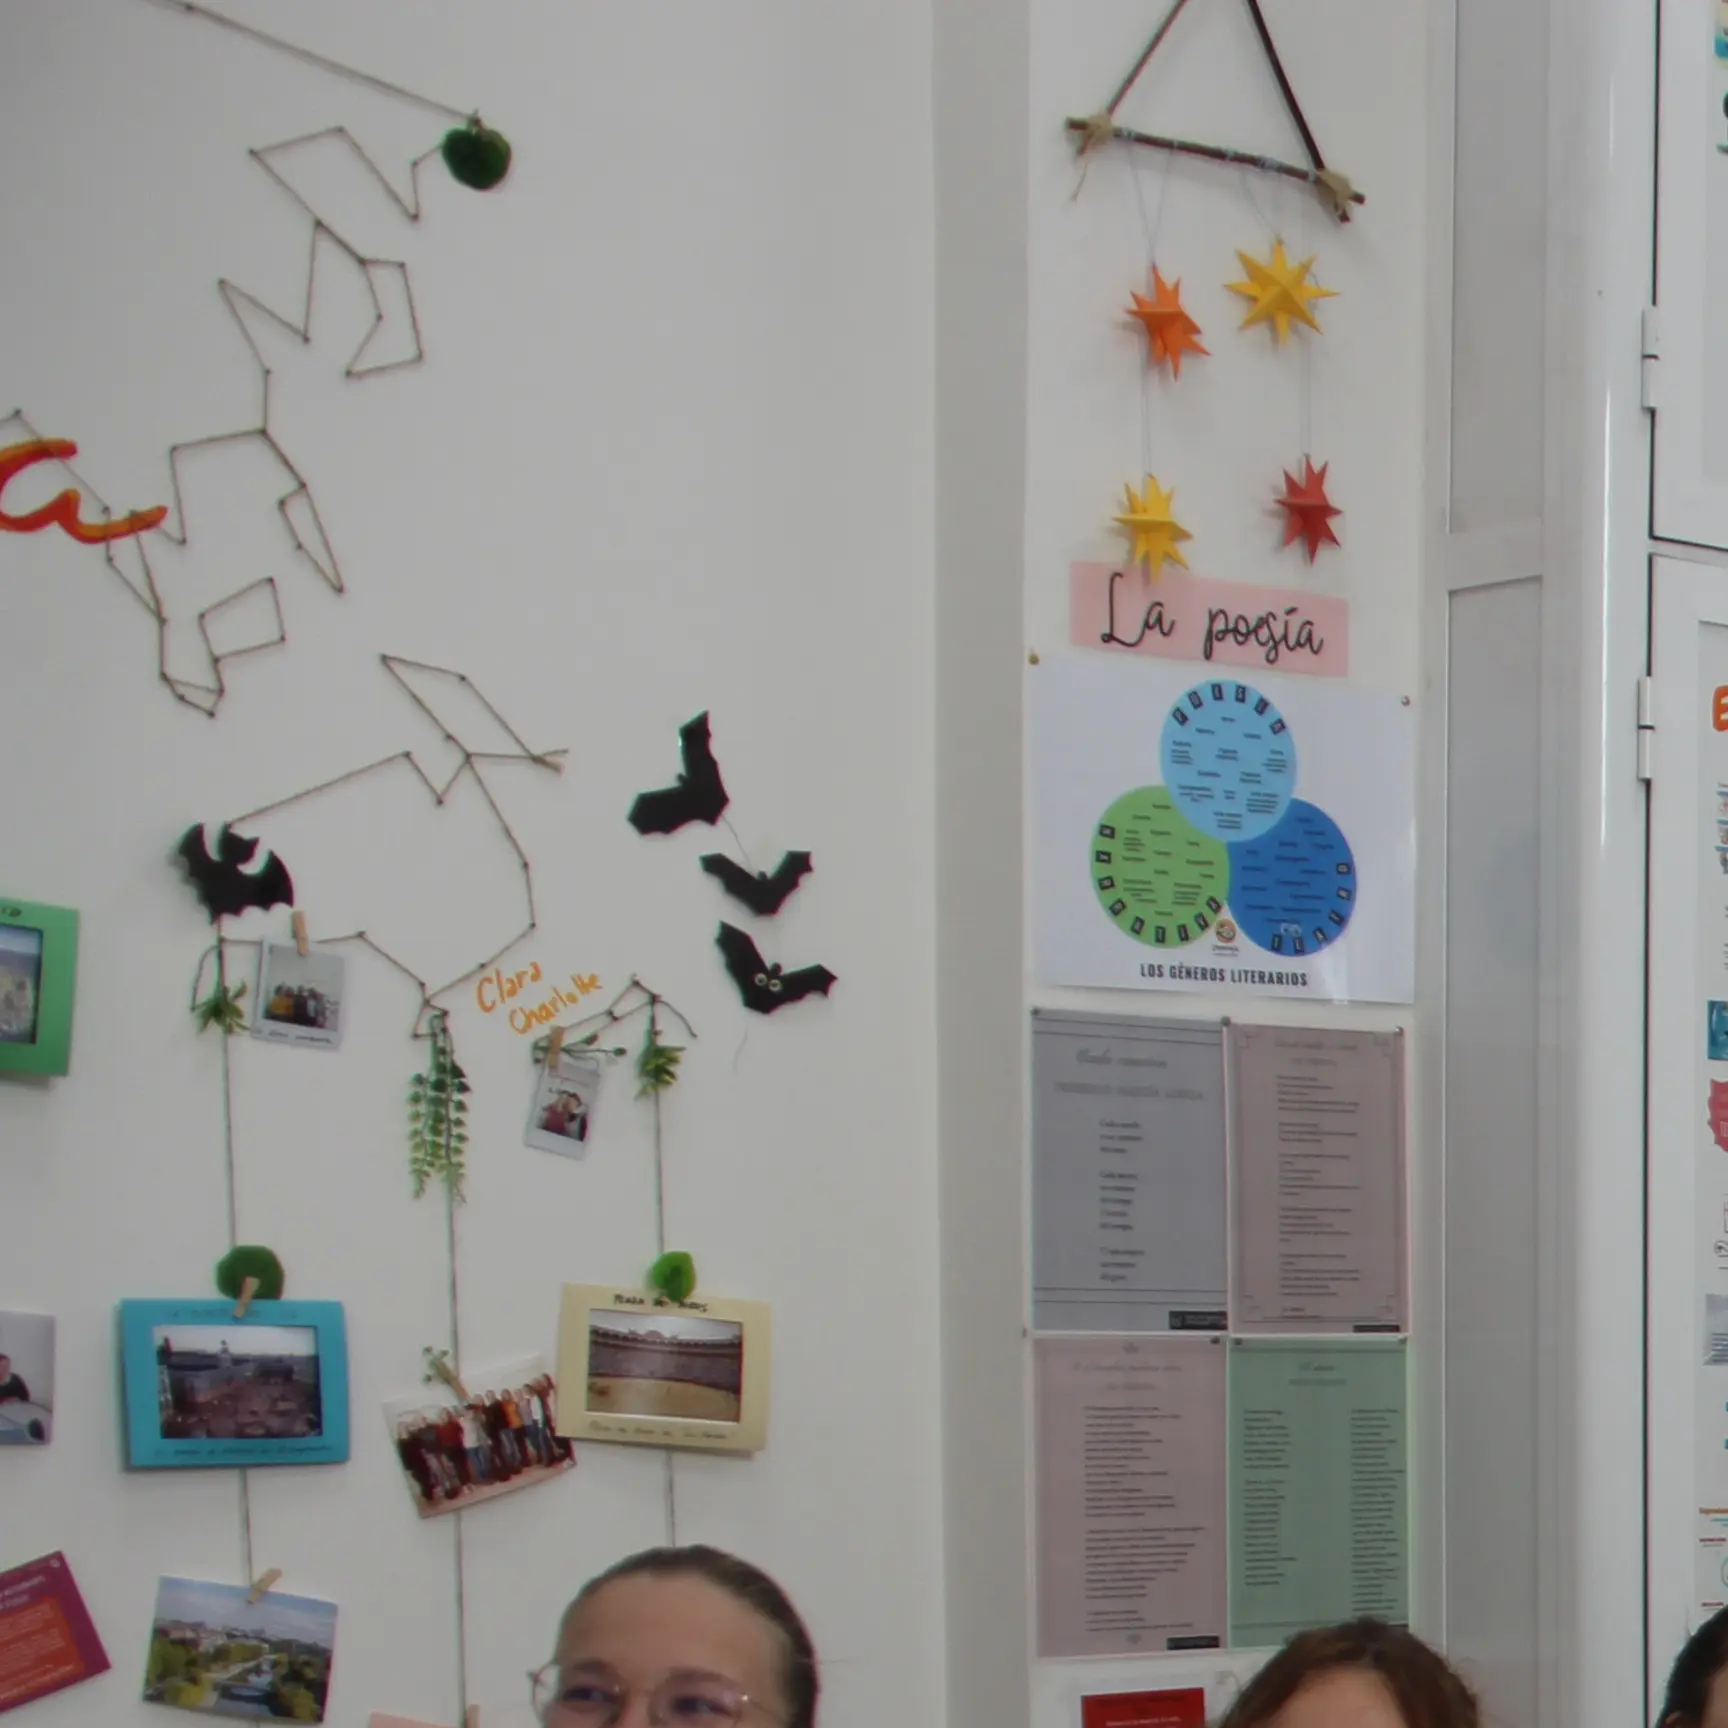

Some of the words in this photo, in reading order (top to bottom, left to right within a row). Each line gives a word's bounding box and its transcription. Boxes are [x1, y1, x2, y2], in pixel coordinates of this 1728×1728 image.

[1101, 572, 1176, 648] La
[1203, 607, 1324, 664] poesía
[477, 961, 542, 1014] Clara
[1141, 963, 1166, 979] LOS
[1169, 961, 1225, 983] GÉNEROS
[1230, 968, 1308, 987] LITERARIOS
